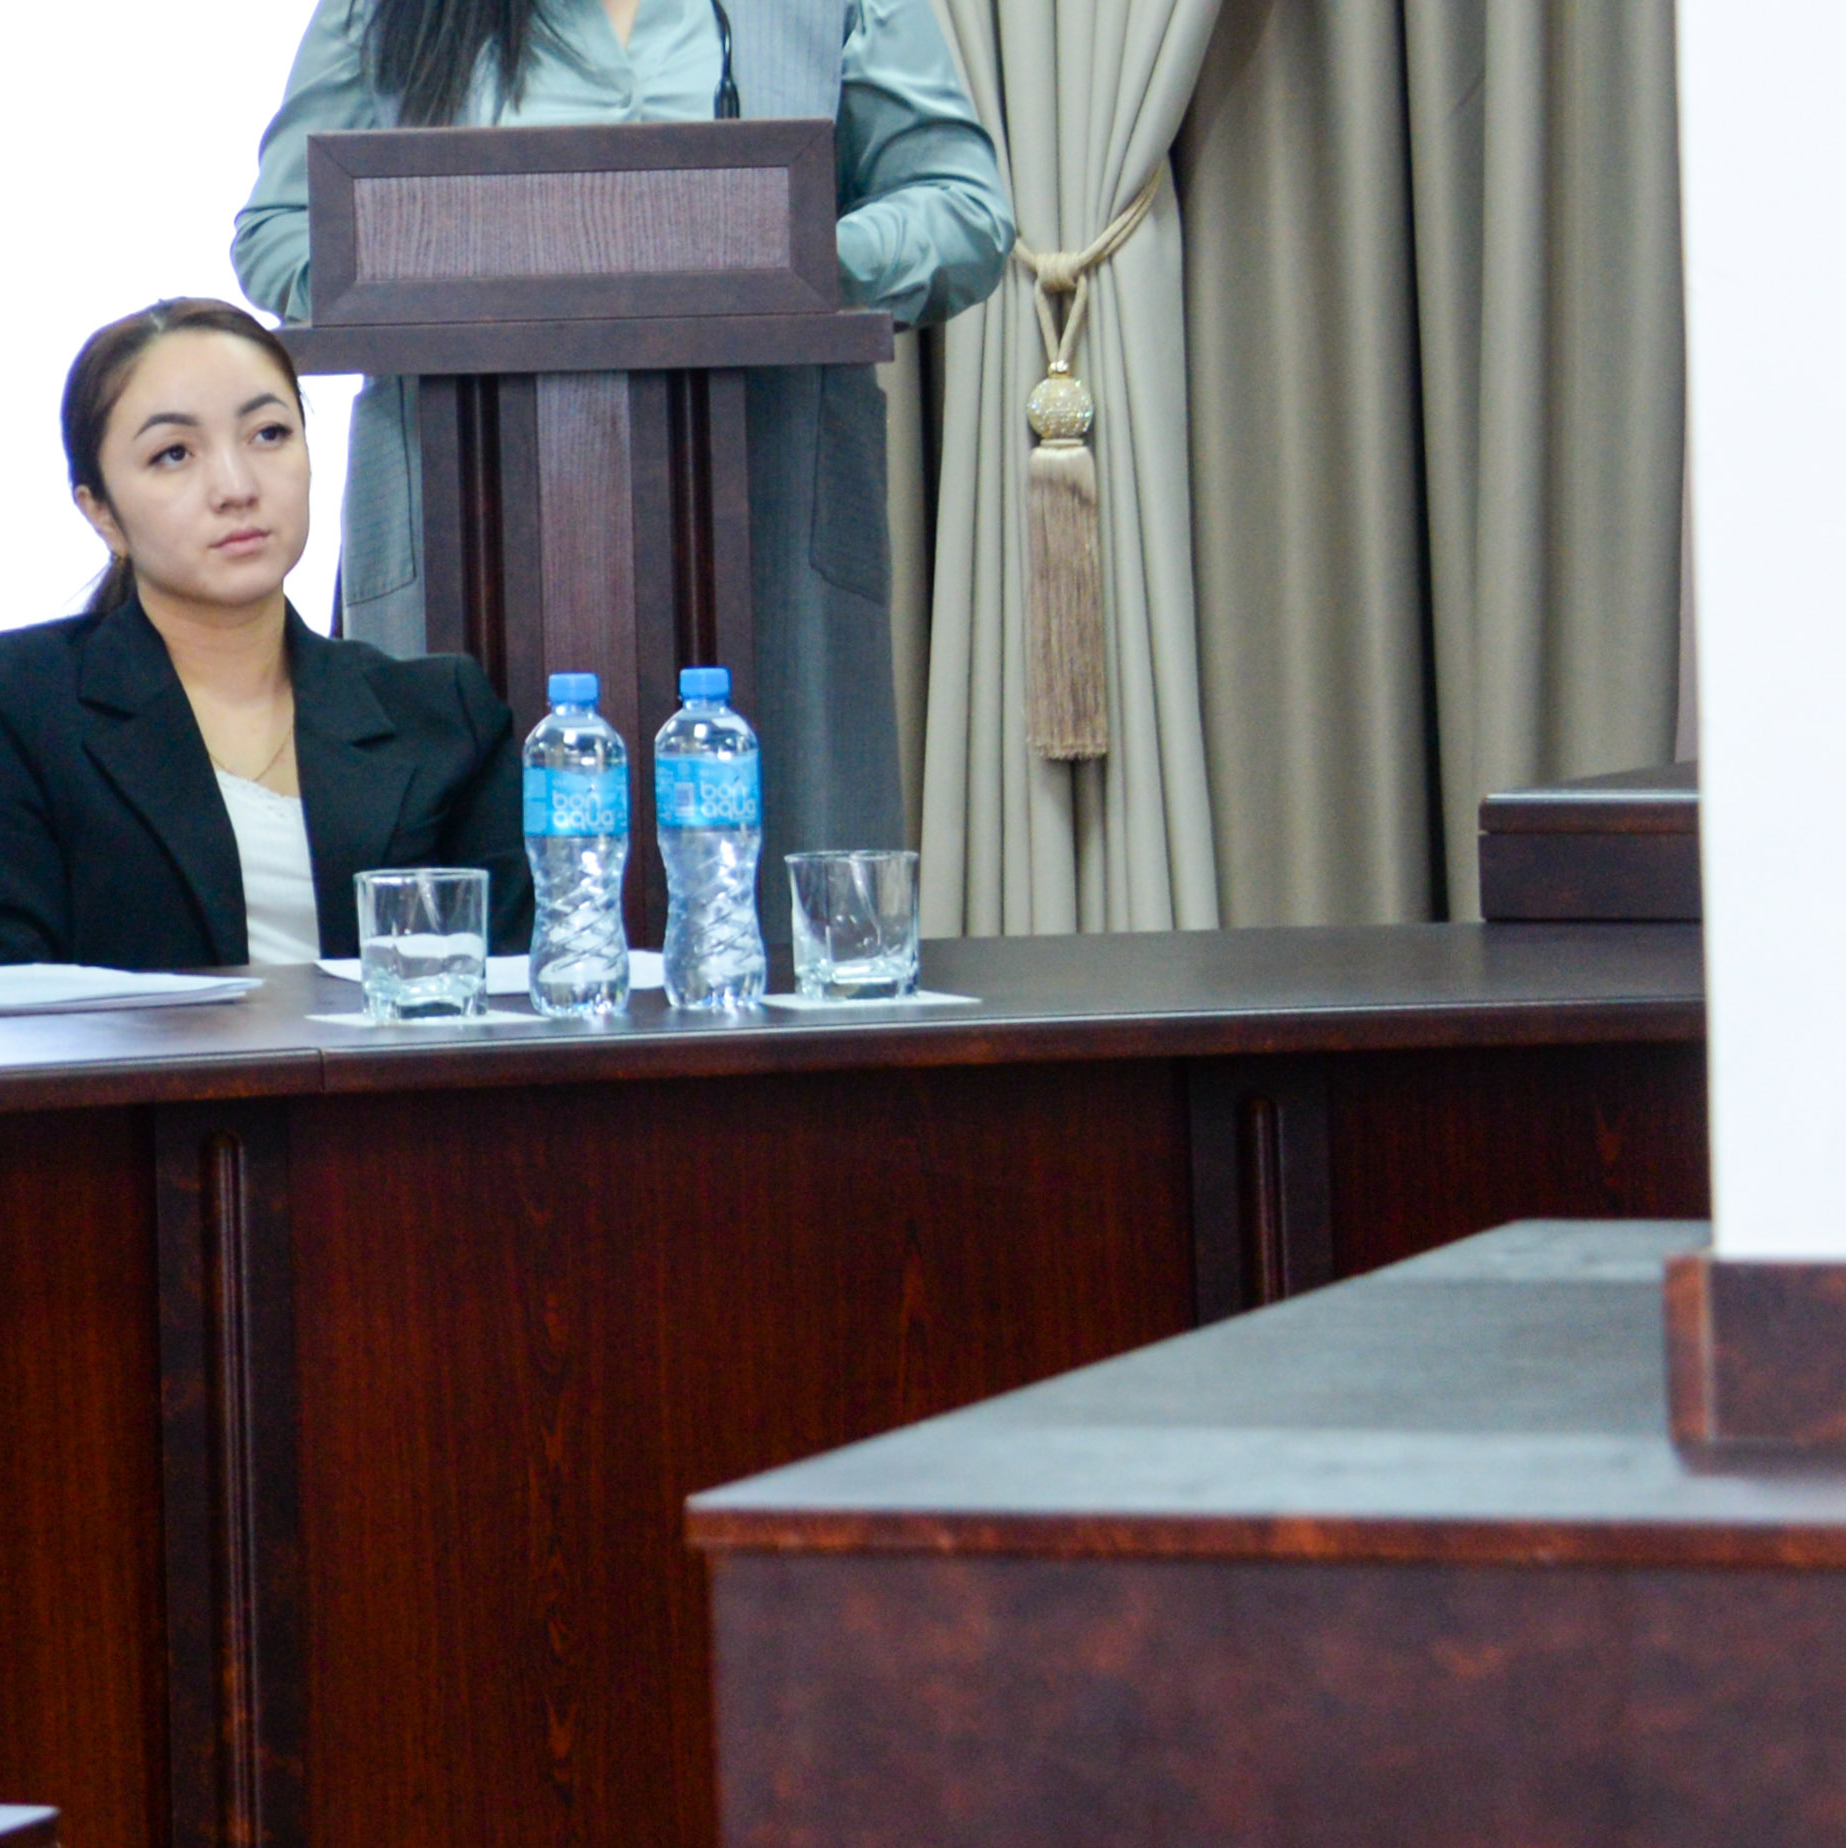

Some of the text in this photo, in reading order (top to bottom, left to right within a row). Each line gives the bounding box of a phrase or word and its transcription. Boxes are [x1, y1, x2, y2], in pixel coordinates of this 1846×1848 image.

[552, 789, 602, 812] bon
[700, 779, 747, 803] bon
[553, 809, 615, 832] aqua
[700, 800, 757, 822] aqua
